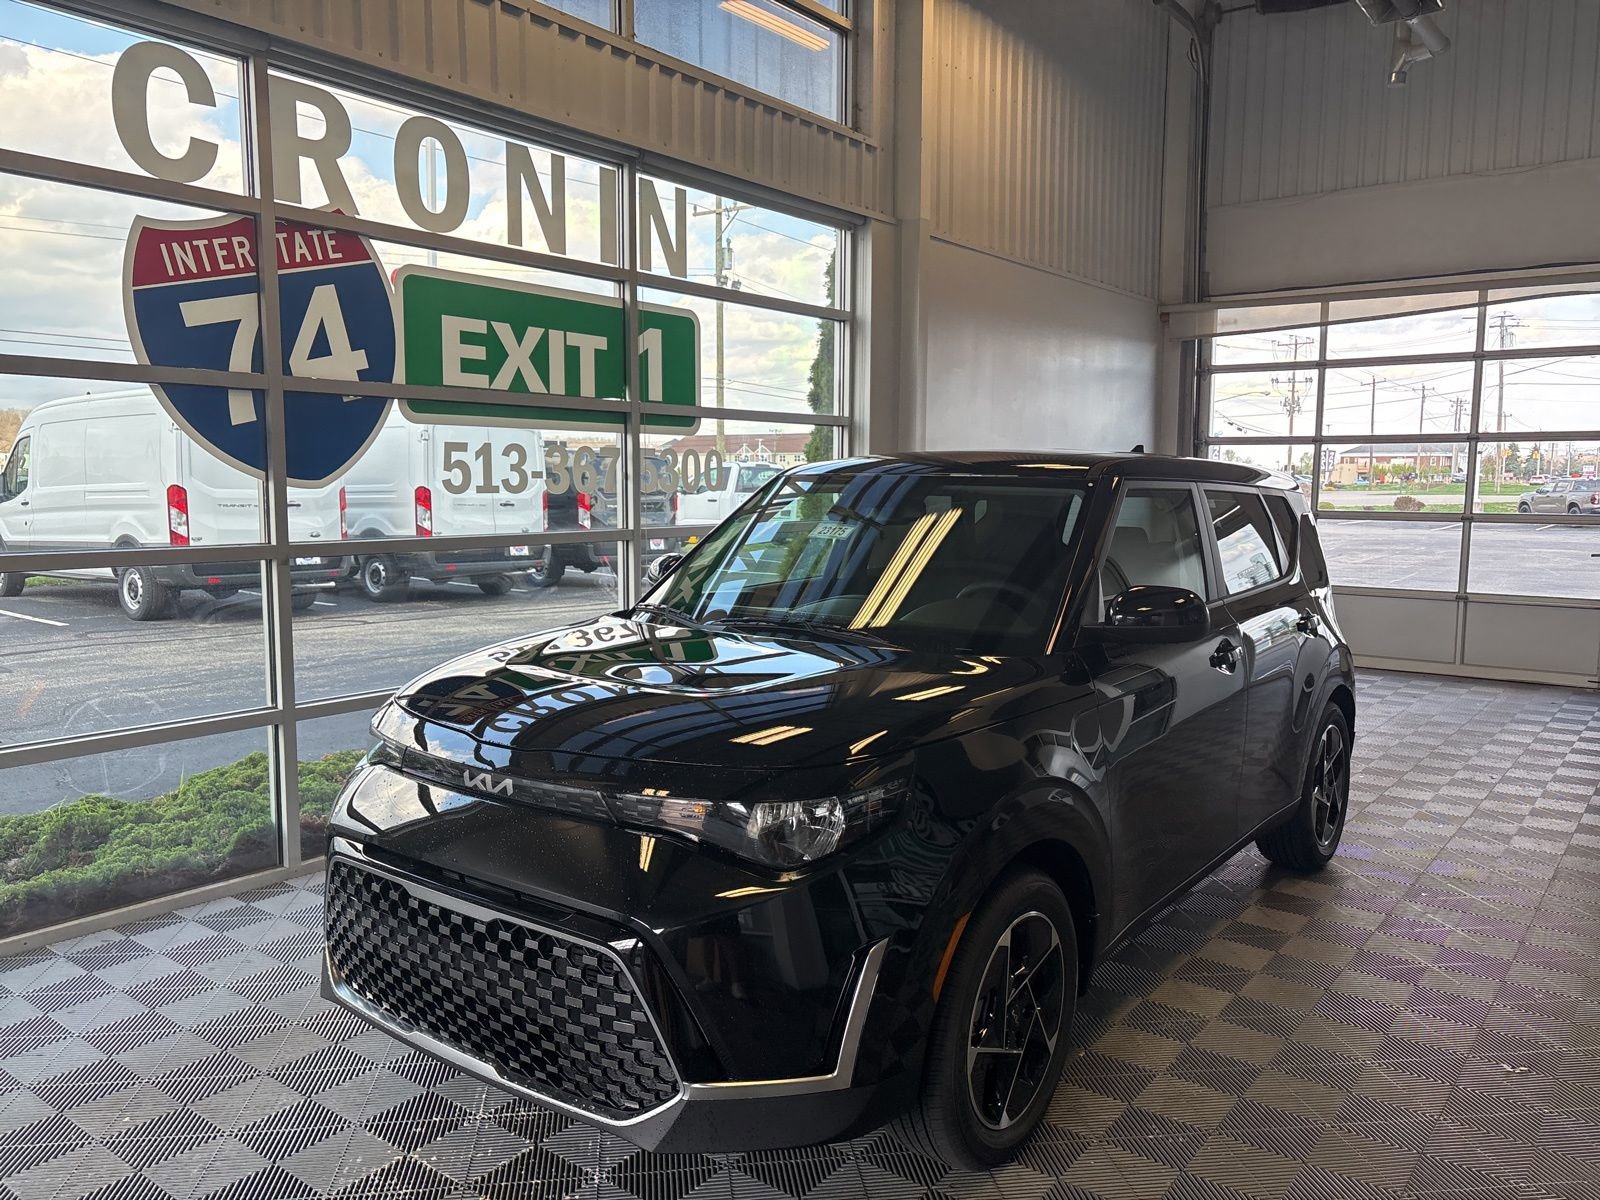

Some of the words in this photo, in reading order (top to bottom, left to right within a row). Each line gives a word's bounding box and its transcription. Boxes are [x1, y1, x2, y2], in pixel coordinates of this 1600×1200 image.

[111, 40, 688, 279] CRONIN
[159, 229, 343, 277] INTERTATE
[178, 283, 369, 426] 74
[441, 314, 608, 398] EXIT
[637, 327, 663, 402] 1
[441, 440, 724, 495] 513-3675300
[463, 768, 514, 797] KIA
